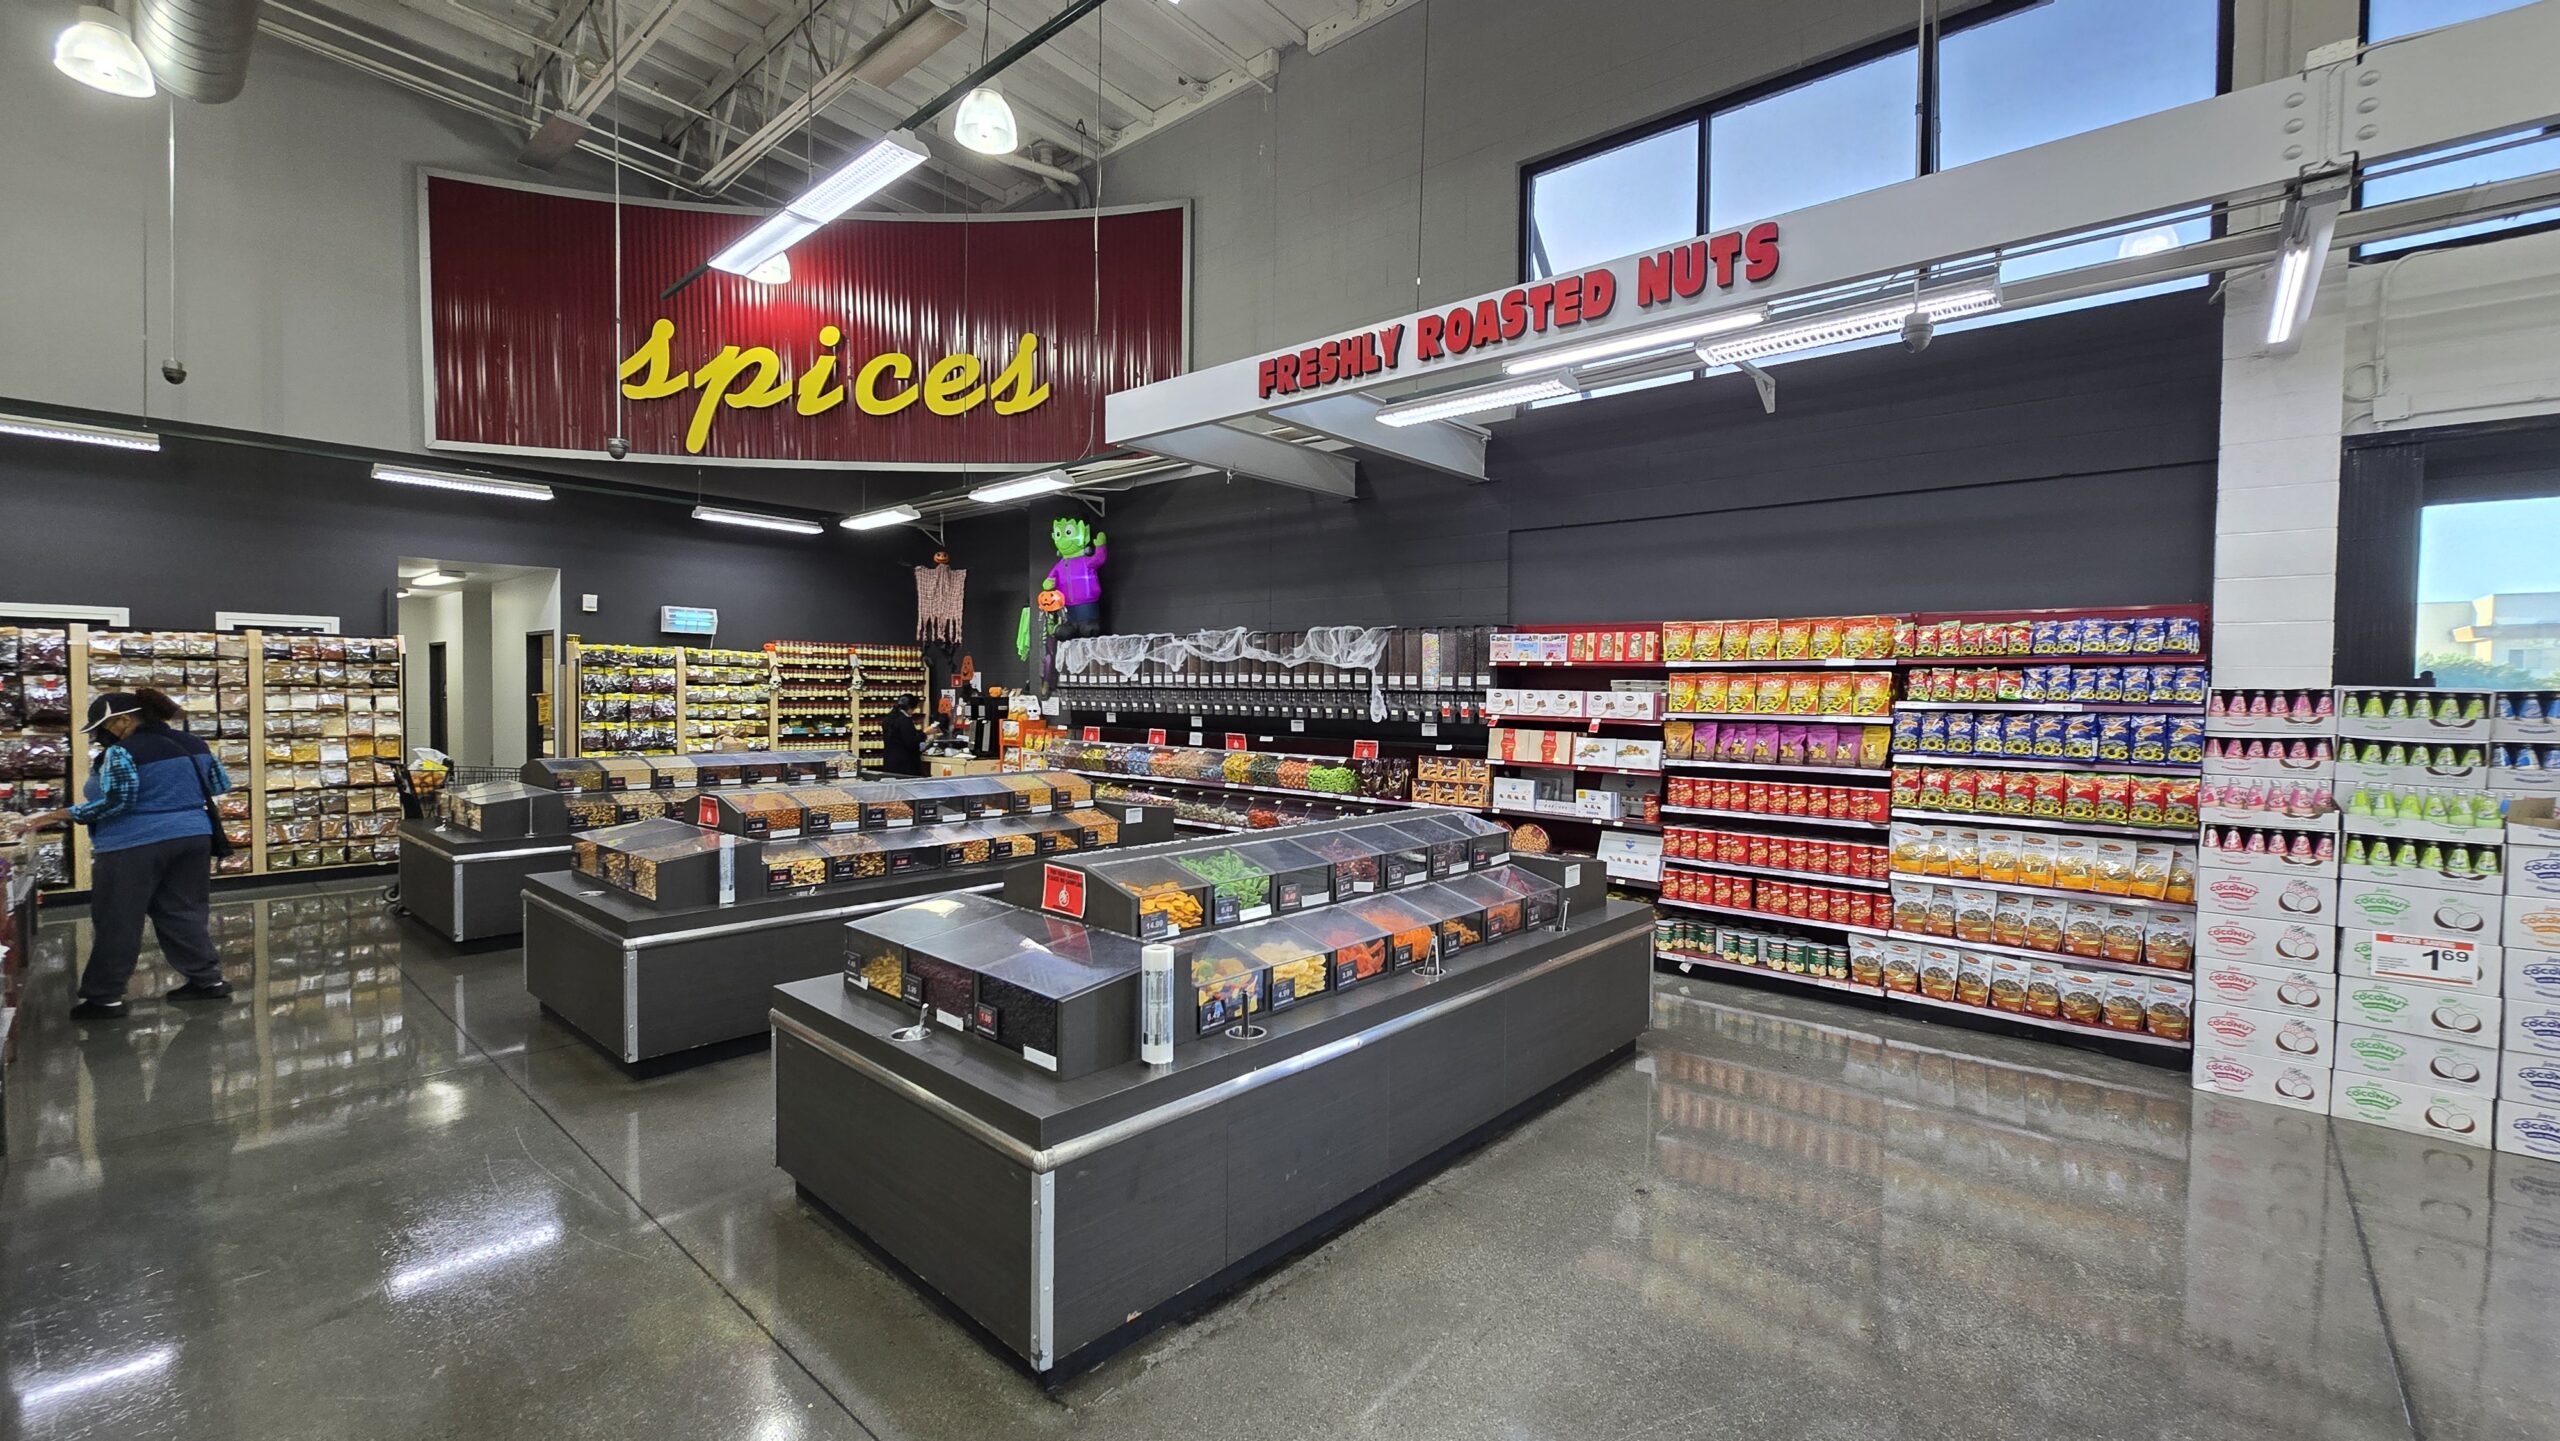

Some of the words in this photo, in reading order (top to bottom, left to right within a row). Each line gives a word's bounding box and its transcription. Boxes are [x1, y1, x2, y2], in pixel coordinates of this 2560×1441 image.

[1259, 323, 1404, 399] FRESHLY
[1416, 269, 1617, 362] ROASTED
[1637, 222, 1780, 307] NUTS
[620, 318, 1051, 455] spices
[2210, 883, 2260, 896] COCONUT
[2354, 895, 2411, 910] COCONUT
[2208, 928, 2257, 941] COCONUT
[2209, 973, 2258, 987] COCONUT
[2352, 992, 2409, 1008] COCONUT
[2207, 1018, 2257, 1033] COCONUT
[2350, 1041, 2407, 1057] COCONUT
[2206, 1062, 2254, 1078] COCONUT
[2345, 1088, 2402, 1105] COCONUT
